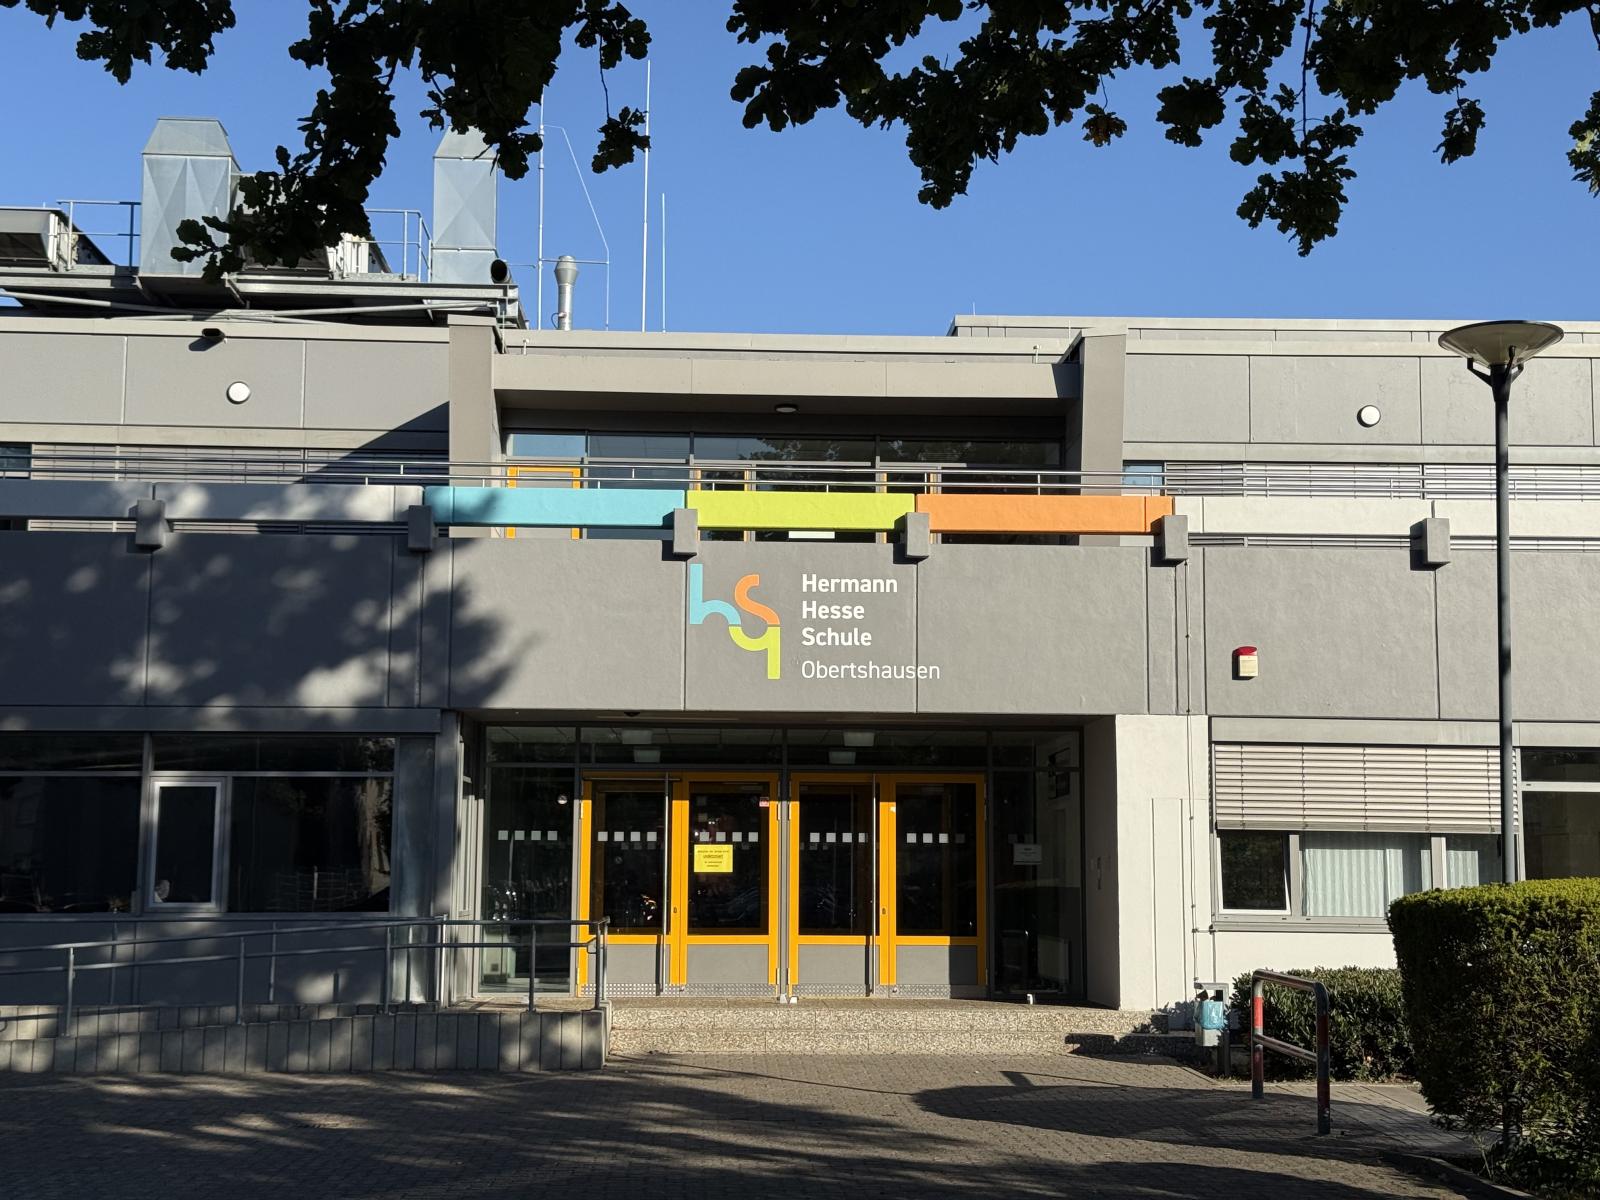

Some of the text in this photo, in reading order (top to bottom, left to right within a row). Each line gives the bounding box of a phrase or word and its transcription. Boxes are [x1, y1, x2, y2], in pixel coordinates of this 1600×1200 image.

[801, 574, 897, 593] Hermann
[801, 601, 865, 620] Hesse
[801, 628, 872, 646] Schule
[801, 660, 940, 679] Obertshausen
